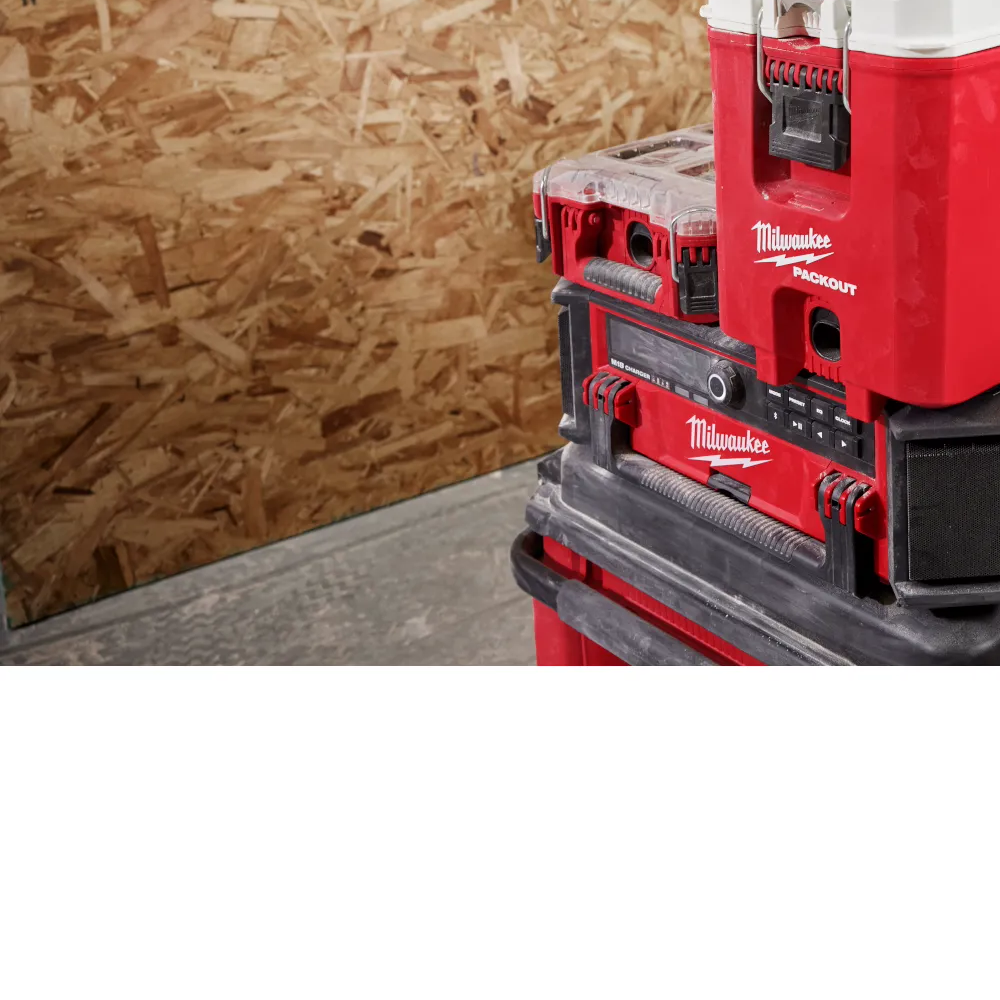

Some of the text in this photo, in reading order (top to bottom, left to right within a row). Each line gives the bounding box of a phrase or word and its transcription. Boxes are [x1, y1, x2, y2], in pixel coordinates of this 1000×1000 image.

[751, 220, 833, 254] Milwaukee
[793, 266, 857, 296] PACKOUT
[625, 364, 651, 380] CHARGER
[685, 414, 771, 455] Milwaukee
